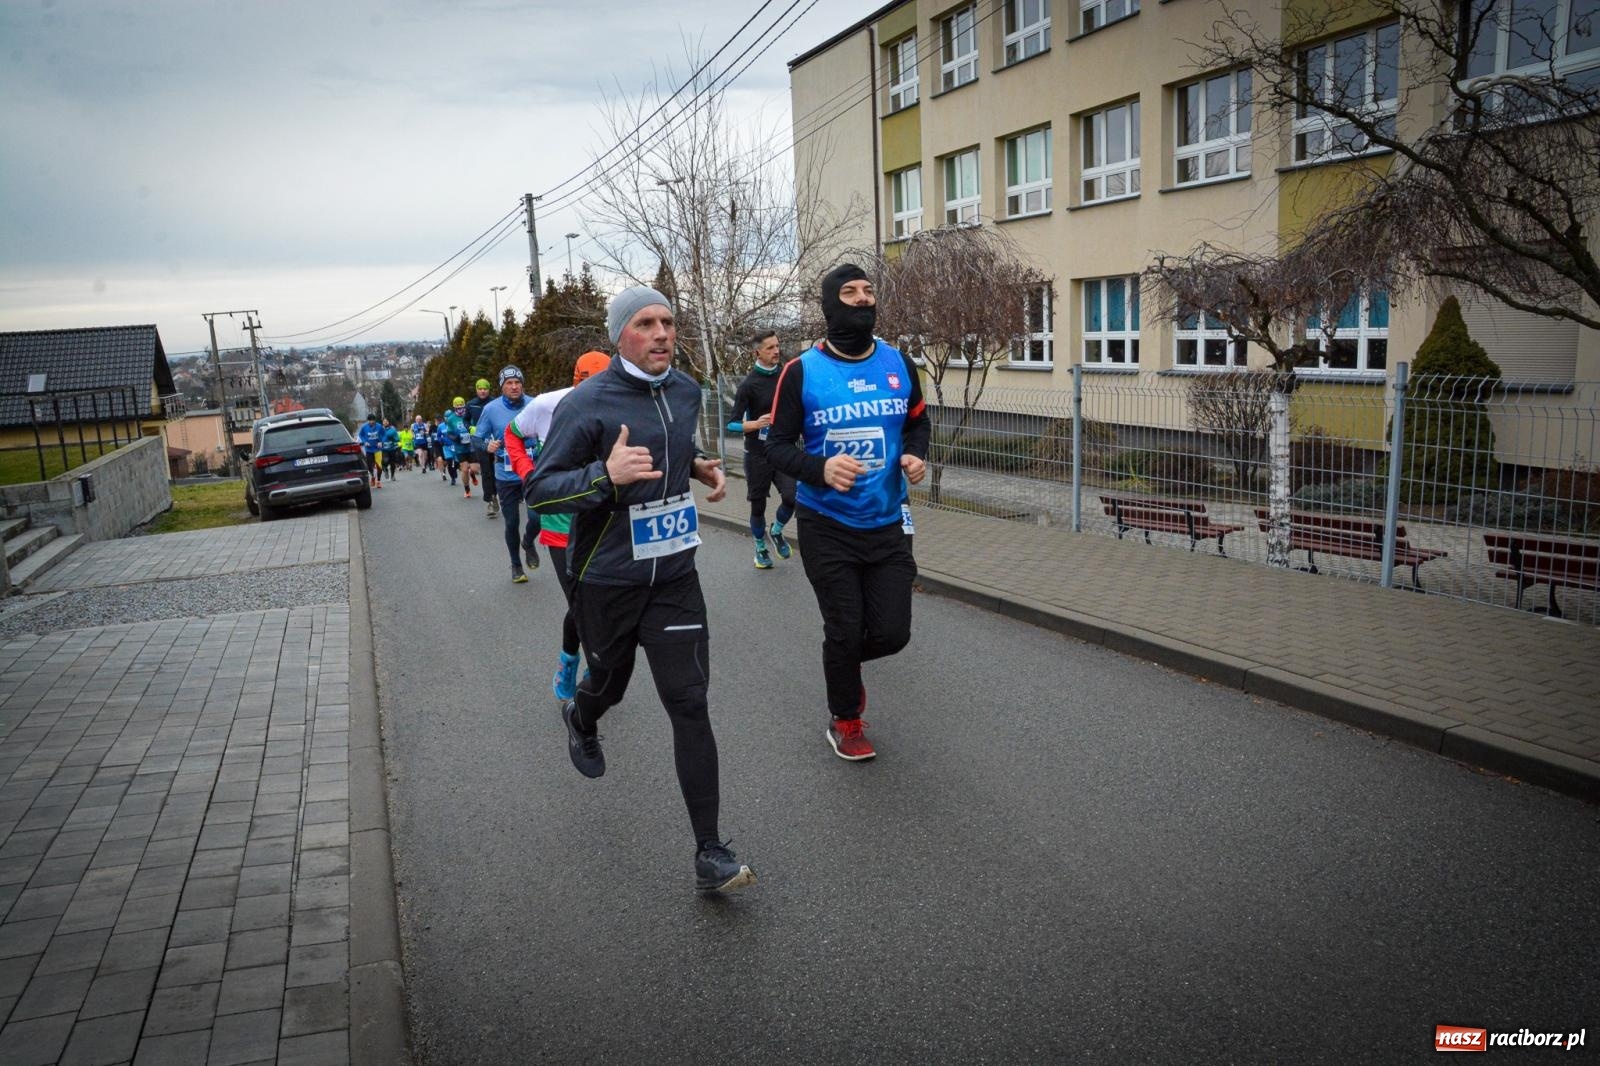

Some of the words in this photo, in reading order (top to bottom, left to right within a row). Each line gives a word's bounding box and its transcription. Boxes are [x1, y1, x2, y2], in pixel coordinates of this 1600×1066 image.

[812, 398, 909, 427] RUNNERS
[833, 439, 875, 459] 222
[646, 510, 689, 541] 196
